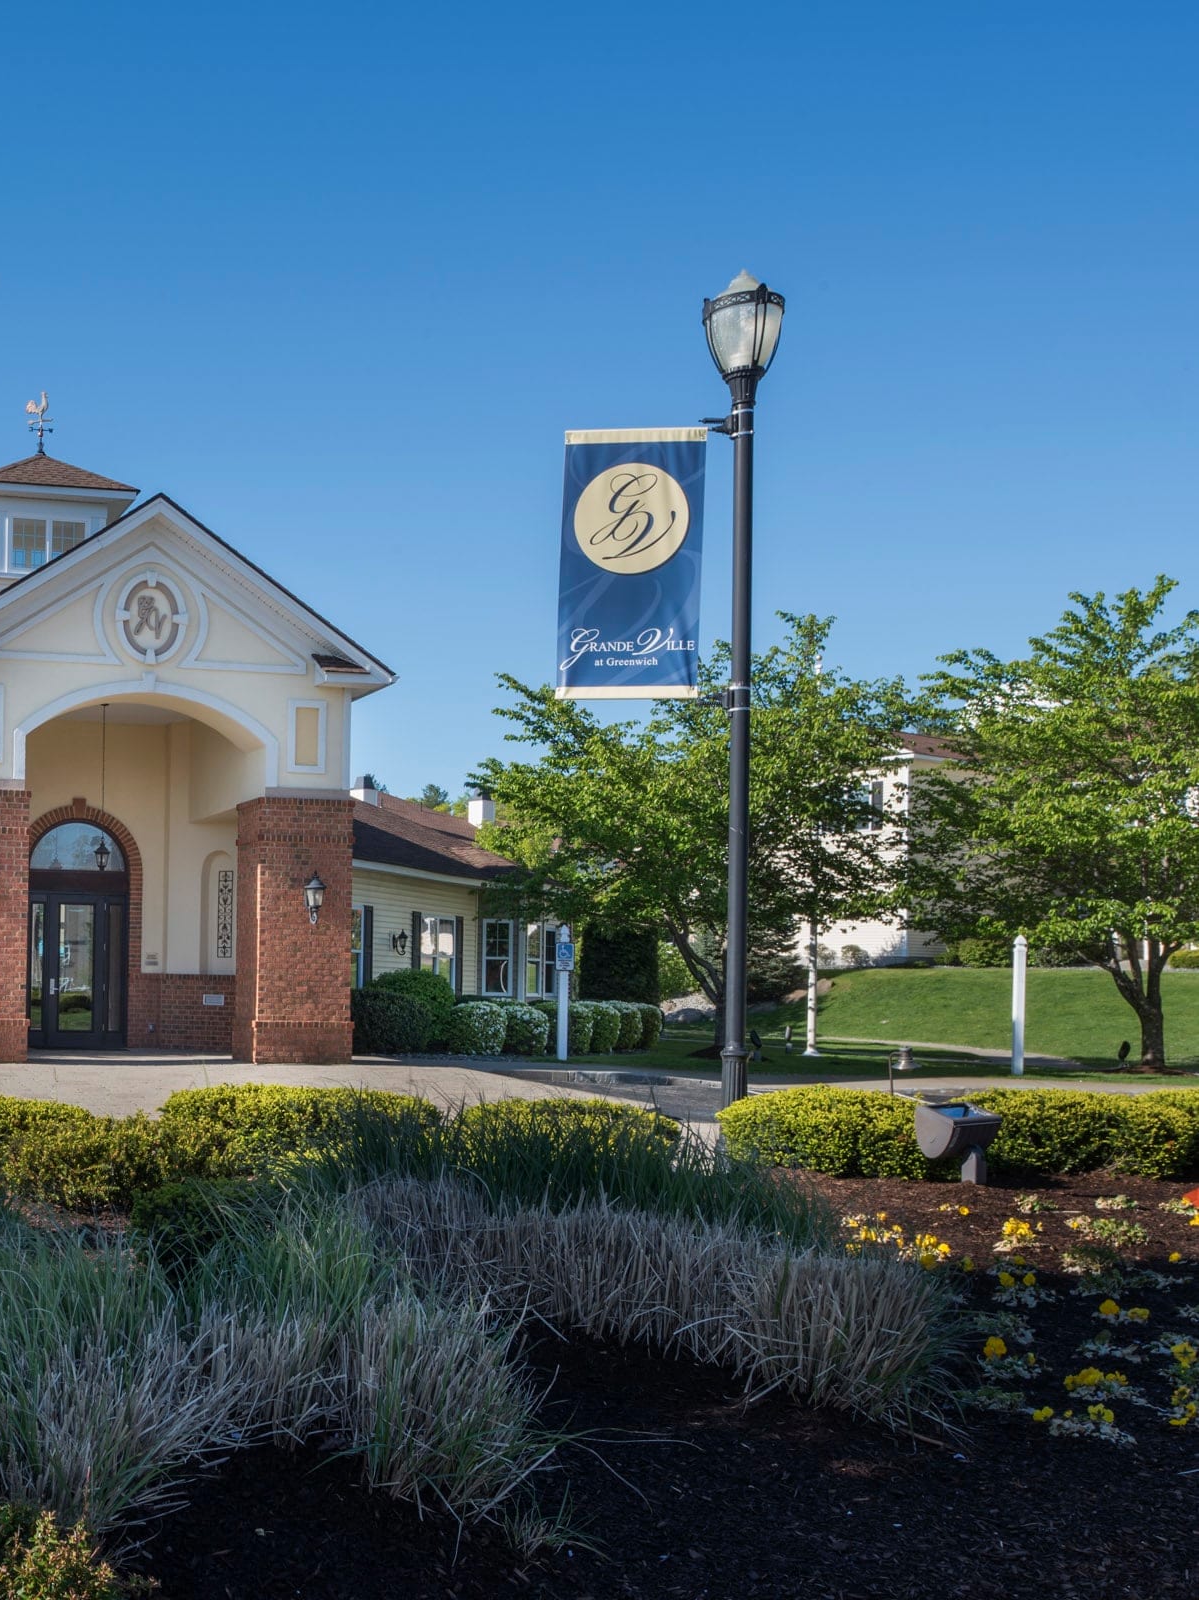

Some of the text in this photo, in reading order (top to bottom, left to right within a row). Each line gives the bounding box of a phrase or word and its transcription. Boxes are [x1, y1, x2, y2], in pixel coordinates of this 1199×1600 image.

[560, 627, 695, 671] GRANDE VILLE
[594, 657, 659, 667] at Greenwich
